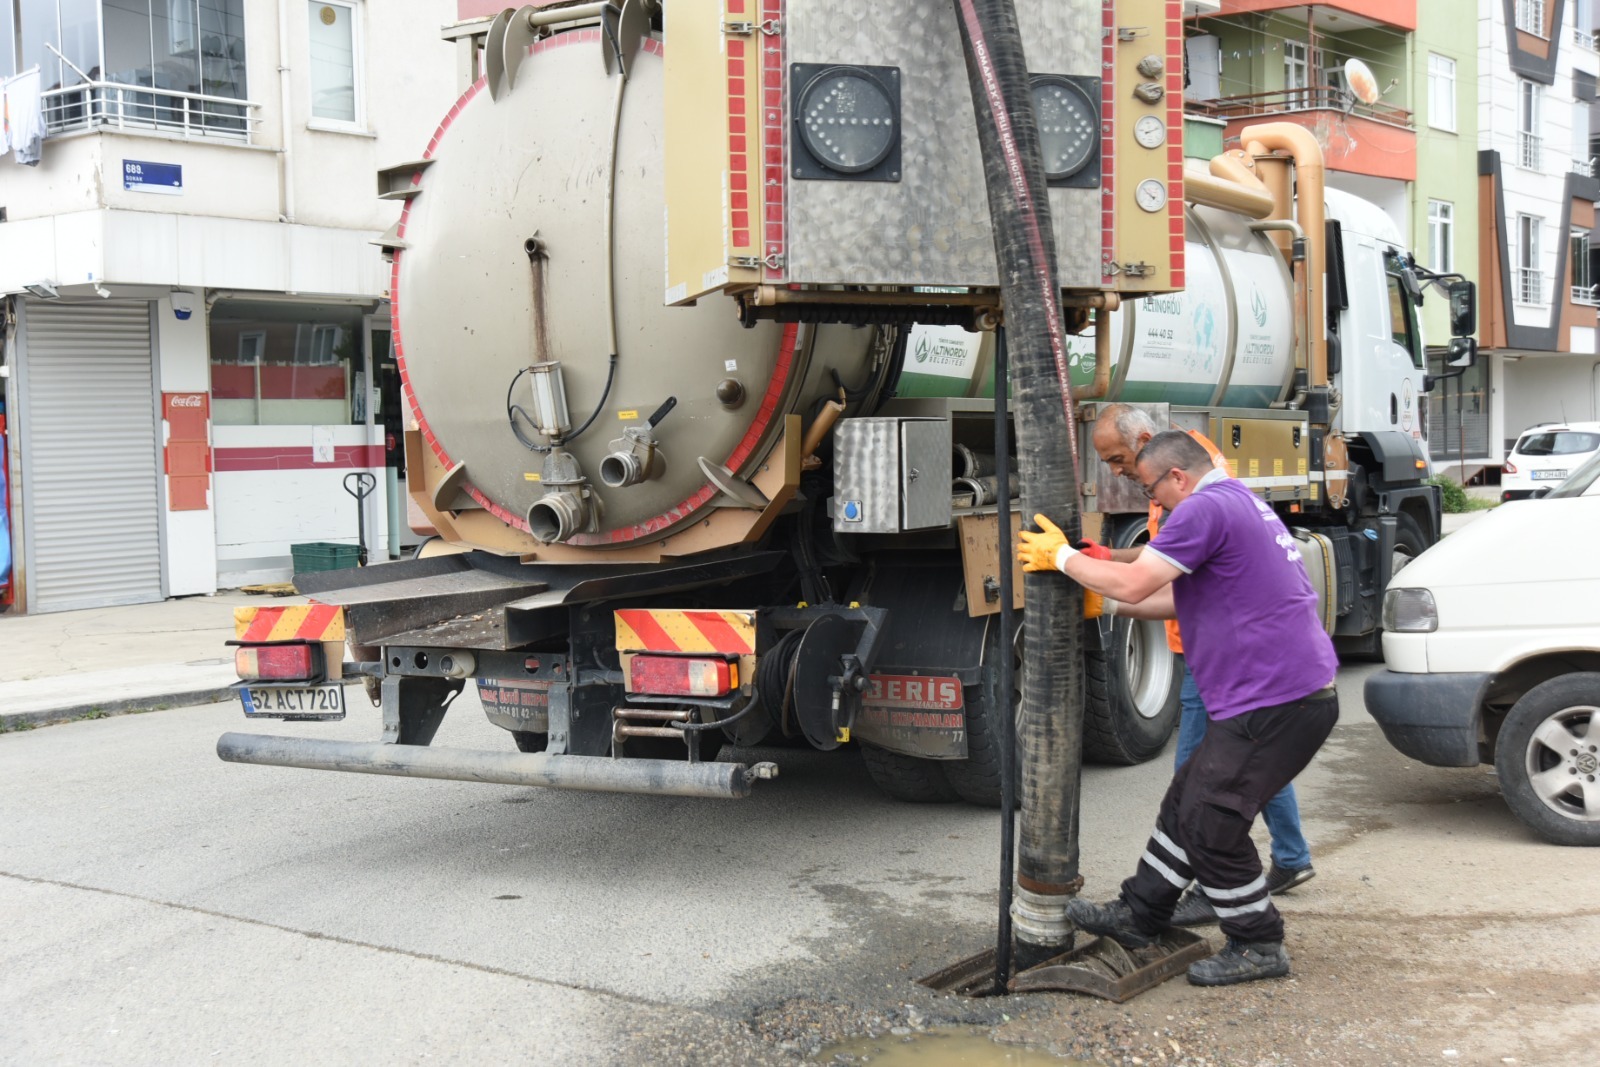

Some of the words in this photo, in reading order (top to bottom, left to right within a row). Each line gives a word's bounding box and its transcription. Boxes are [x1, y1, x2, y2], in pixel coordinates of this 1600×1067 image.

[125, 163, 144, 174] 689.
[931, 345, 968, 358] ALTINORDU
[250, 690, 273, 710] 52
[867, 679, 956, 707] BERİŞ
